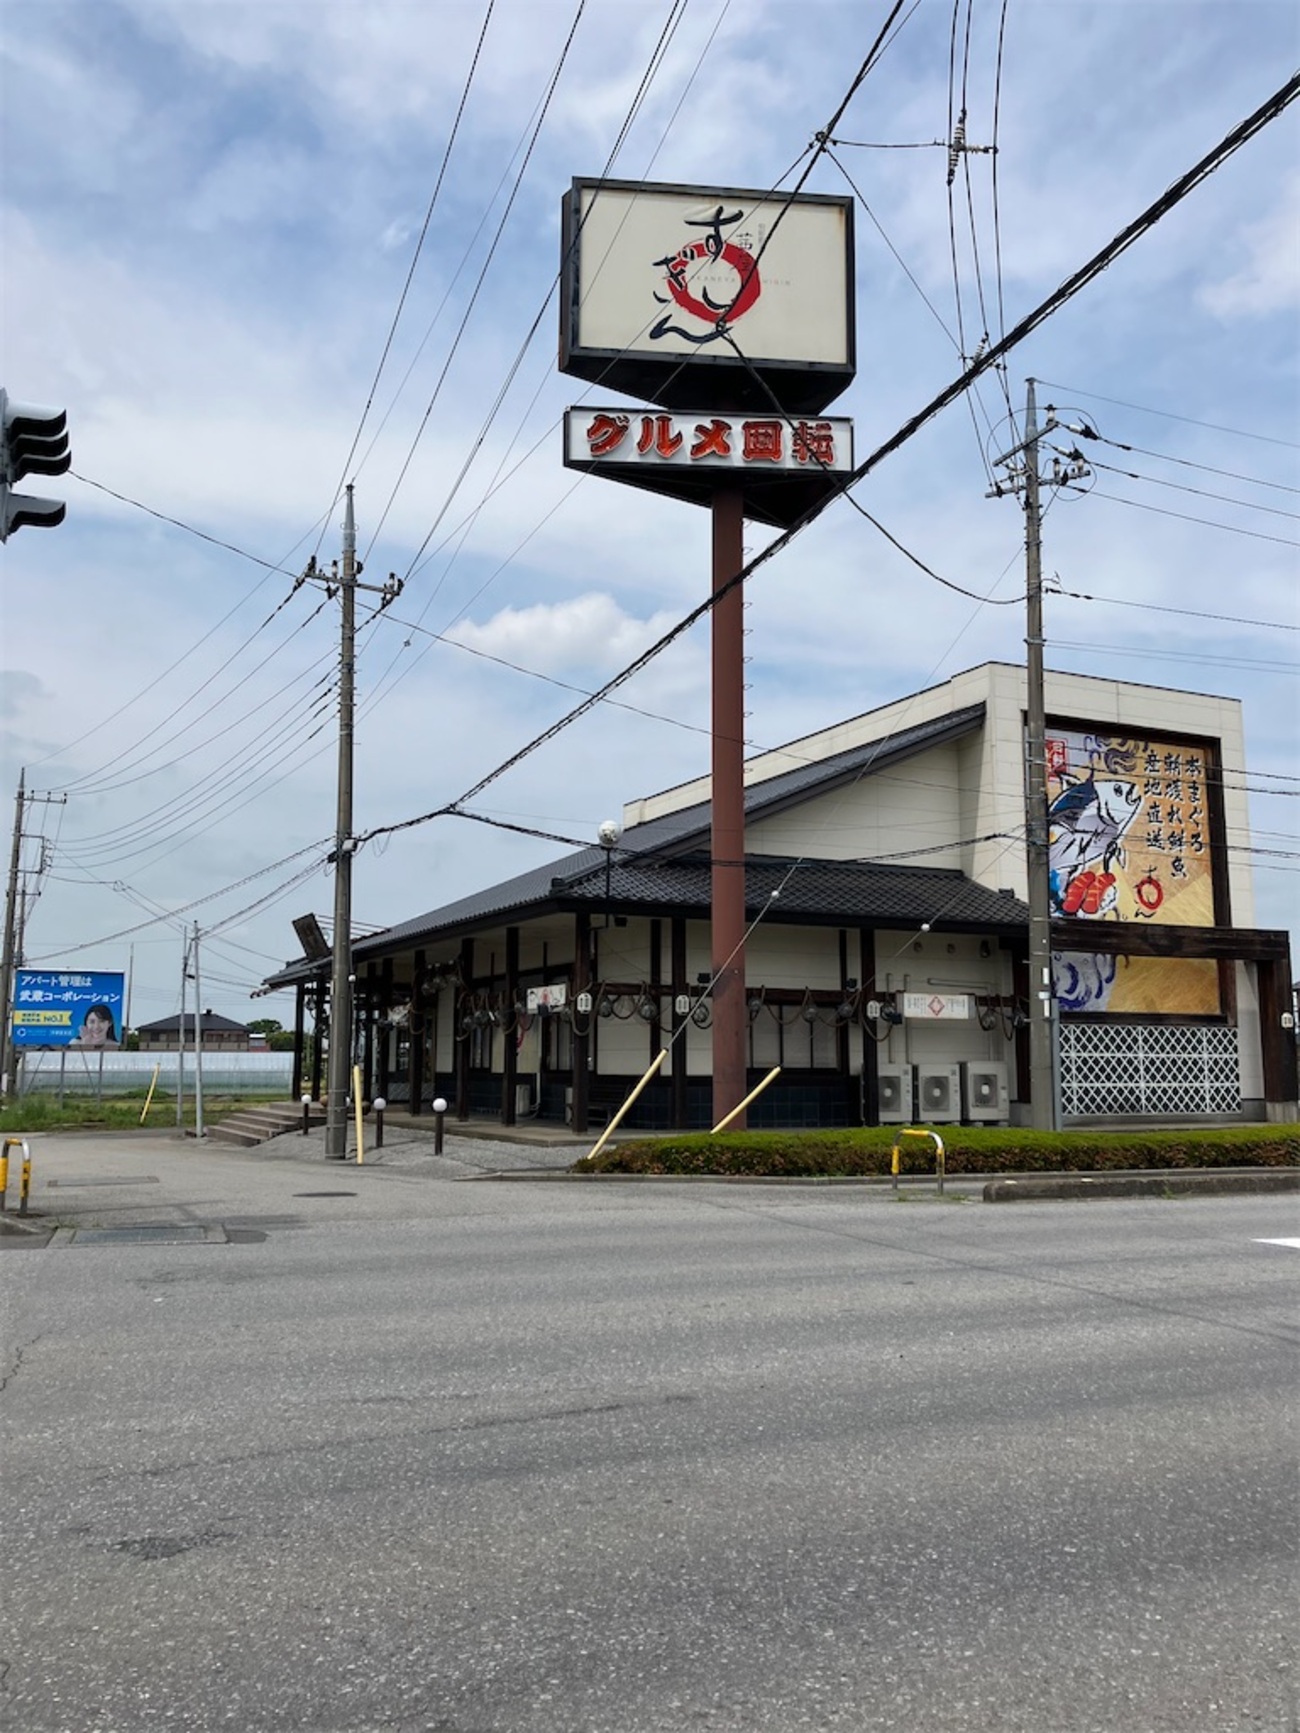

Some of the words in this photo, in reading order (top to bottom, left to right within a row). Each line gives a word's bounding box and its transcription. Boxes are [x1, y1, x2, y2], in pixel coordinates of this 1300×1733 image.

[586, 415, 835, 465] グルメ回転
[1143, 750, 1165, 851] 産地直送
[1185, 755, 1204, 853] 本まぐろ
[19, 990, 120, 1003] 武蔵コーポレーション
[21, 975, 93, 987] アパート管理は
